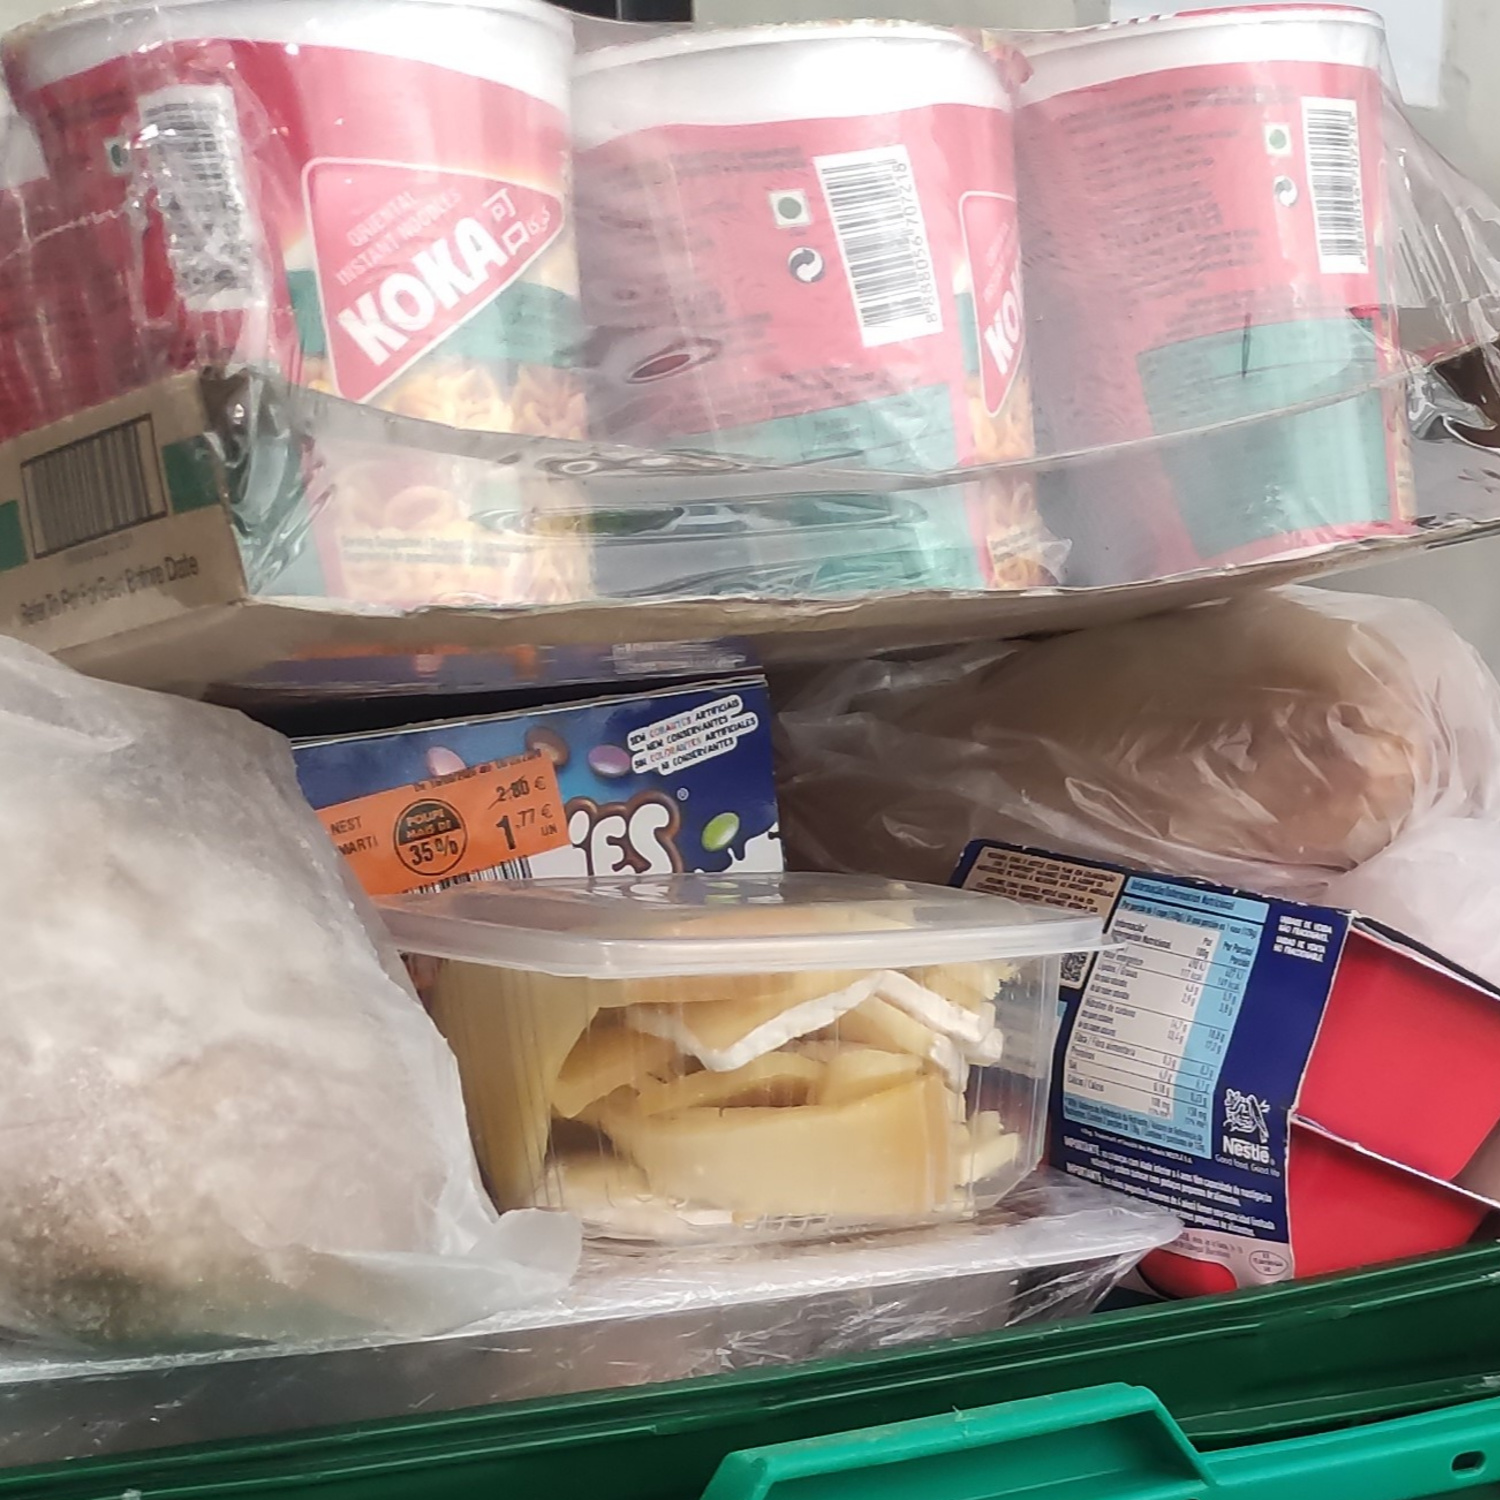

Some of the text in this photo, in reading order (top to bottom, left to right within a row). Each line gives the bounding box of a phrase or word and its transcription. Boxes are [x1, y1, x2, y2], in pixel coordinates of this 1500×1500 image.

[893, 163, 918, 225] 707218
[334, 234, 401, 287] INSTANT
[336, 216, 509, 366] KOKA
[162, 548, 200, 582] Date
[693, 699, 740, 720] ARTIFICIAIS
[666, 715, 728, 744] CONSERVANTES
[704, 717, 756, 741] ARTIFICIALES
[672, 737, 734, 766] CONSERVANTES
[331, 815, 362, 835] NEST
[1223, 1135, 1270, 1163] Nestlé
